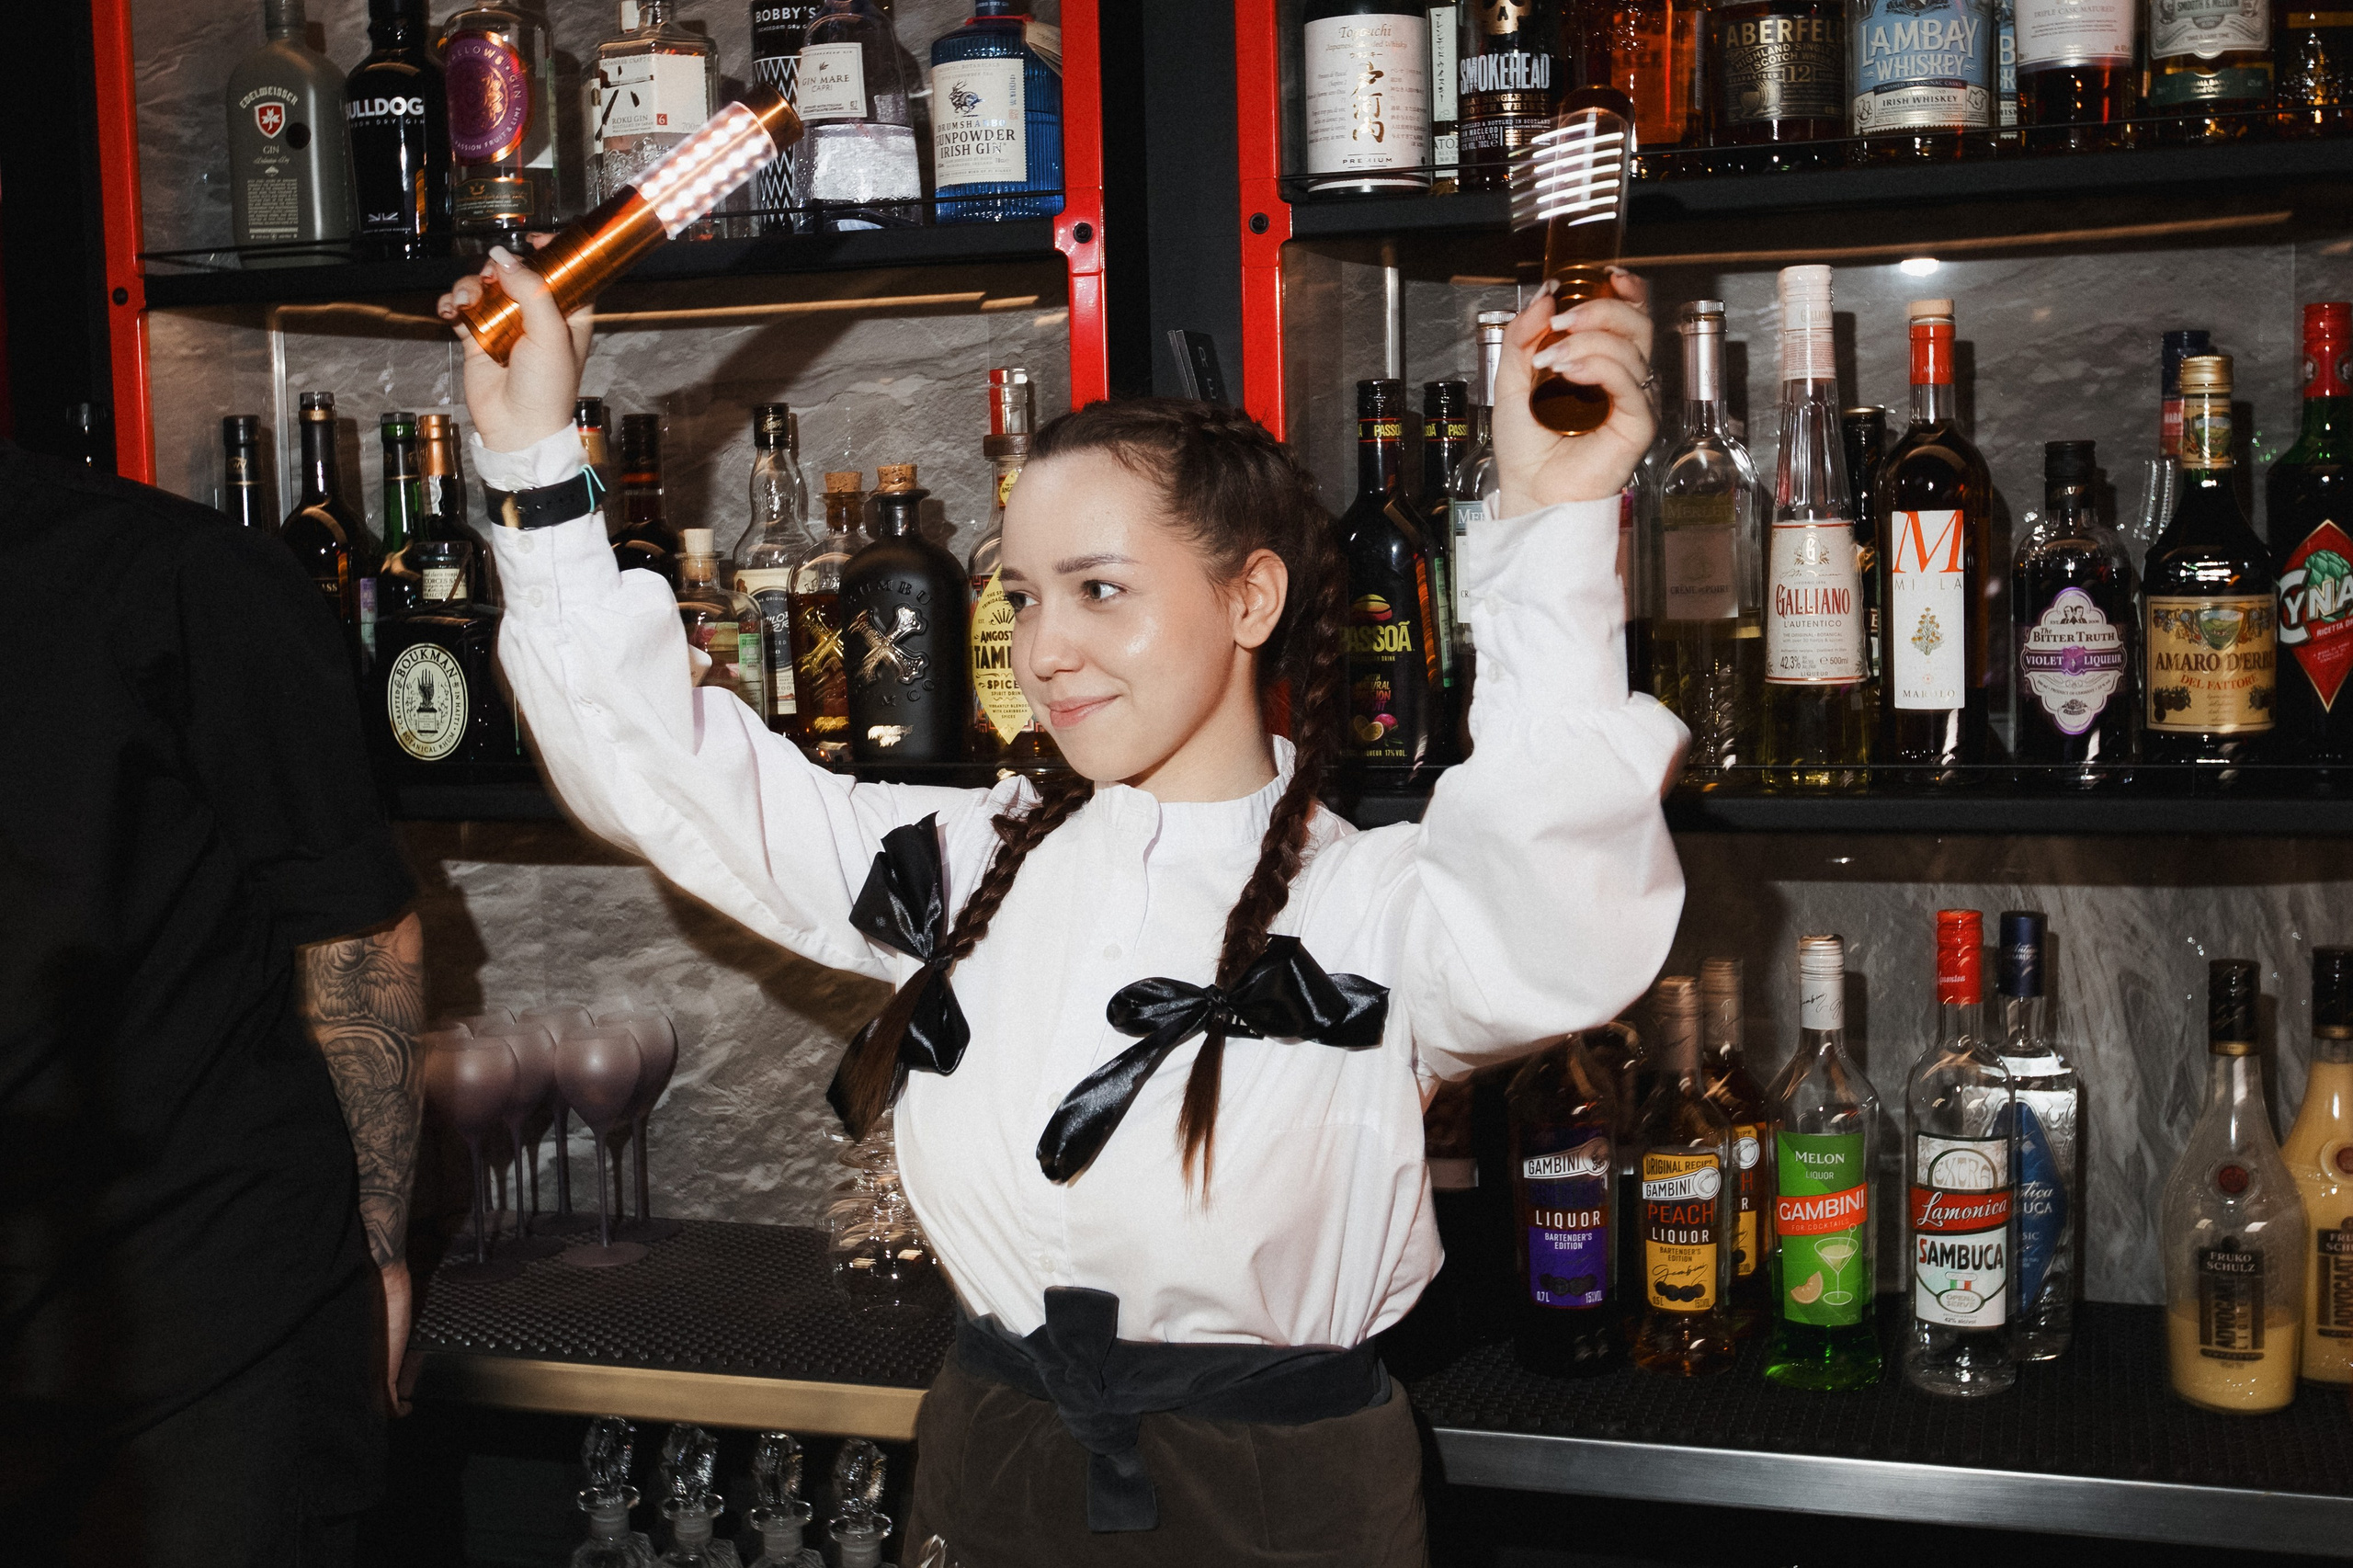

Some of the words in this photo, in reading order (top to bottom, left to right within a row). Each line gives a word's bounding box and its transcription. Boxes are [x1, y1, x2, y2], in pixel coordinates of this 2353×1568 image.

[756, 6, 817, 23] BOBBY'S
[1861, 16, 1979, 68] LAMBAY
[1735, 44, 1790, 71] HIGHLAND
[1755, 52, 1798, 71] SCOTCH
[1460, 52, 1551, 95] SMOKEHEAD
[1789, 65, 1812, 83] 12
[1876, 54, 1967, 82] WHISKEY
[508, 75, 522, 99] GIN
[802, 77, 817, 86] GIN
[820, 74, 850, 84] MARE
[1878, 82, 1908, 92] FINISHED
[812, 85, 833, 93] CAPRI
[1483, 93, 1522, 103] SINGLE
[1882, 97, 1910, 107] IRISH
[1912, 96, 1959, 105] WHISKEY
[612, 115, 632, 125] ROKU
[634, 114, 649, 122] GIN
[658, 114, 666, 125] 6
[484, 131, 506, 149] FRUIT
[1469, 127, 1499, 137] MACLEOD
[263, 144, 280, 154] GIN
[940, 143, 972, 159] IRISH
[1893, 510, 1965, 574] M
[1894, 577, 1963, 592] MILA
[1776, 584, 1850, 619] GALLIANO
[1784, 619, 1842, 629] L'AUTENTICO
[2316, 623, 2345, 638] RICETTA
[980, 631, 1013, 643] ANGOST
[2033, 631, 2075, 642] BITTER
[2075, 631, 2116, 642] TRUTH
[396, 649, 458, 678] BOUKMAN
[1779, 655, 1802, 670] 42,3%
[1830, 656, 1849, 665] 500ml
[2026, 655, 2064, 666] VIOLET
[2084, 653, 2122, 667] LIQUEUR
[2155, 652, 2221, 672] AMARO
[987, 679, 1020, 690] SPICE
[2180, 674, 2206, 689] DEL
[2207, 675, 2258, 690] FATTORE
[394, 689, 404, 725] CRAFTED
[453, 702, 461, 726] HAITI
[403, 732, 438, 753] BOTANICAL
[438, 732, 455, 751] RHUM
[1528, 1155, 1580, 1176] GAMBINI
[1795, 1151, 1846, 1165] MELON
[1645, 1157, 1683, 1176] ORIGINAL
[1934, 1157, 1993, 1187] EXTRA
[1805, 1171, 1835, 1180] LIQUOR
[1645, 1178, 1691, 1198] GAMBINI
[1779, 1188, 1865, 1221] GAMBINI
[1916, 1191, 2007, 1228] Lamonica
[1536, 1210, 1600, 1230] LIQUOR
[1647, 1201, 1715, 1225] PEACH
[1808, 1219, 1850, 1232] COCKTAILS
[1545, 1233, 1593, 1242] BARTENDER'S
[1652, 1227, 1710, 1244] LIQUOR
[1554, 1242, 1583, 1250] EDITION
[1659, 1246, 1701, 1256] BARTENDER'S
[1919, 1237, 2004, 1271] SAMBUCA
[1668, 1255, 1692, 1263] EDITION
[2210, 1252, 2252, 1263] FRUKO
[2207, 1261, 2256, 1273] SCHULZ
